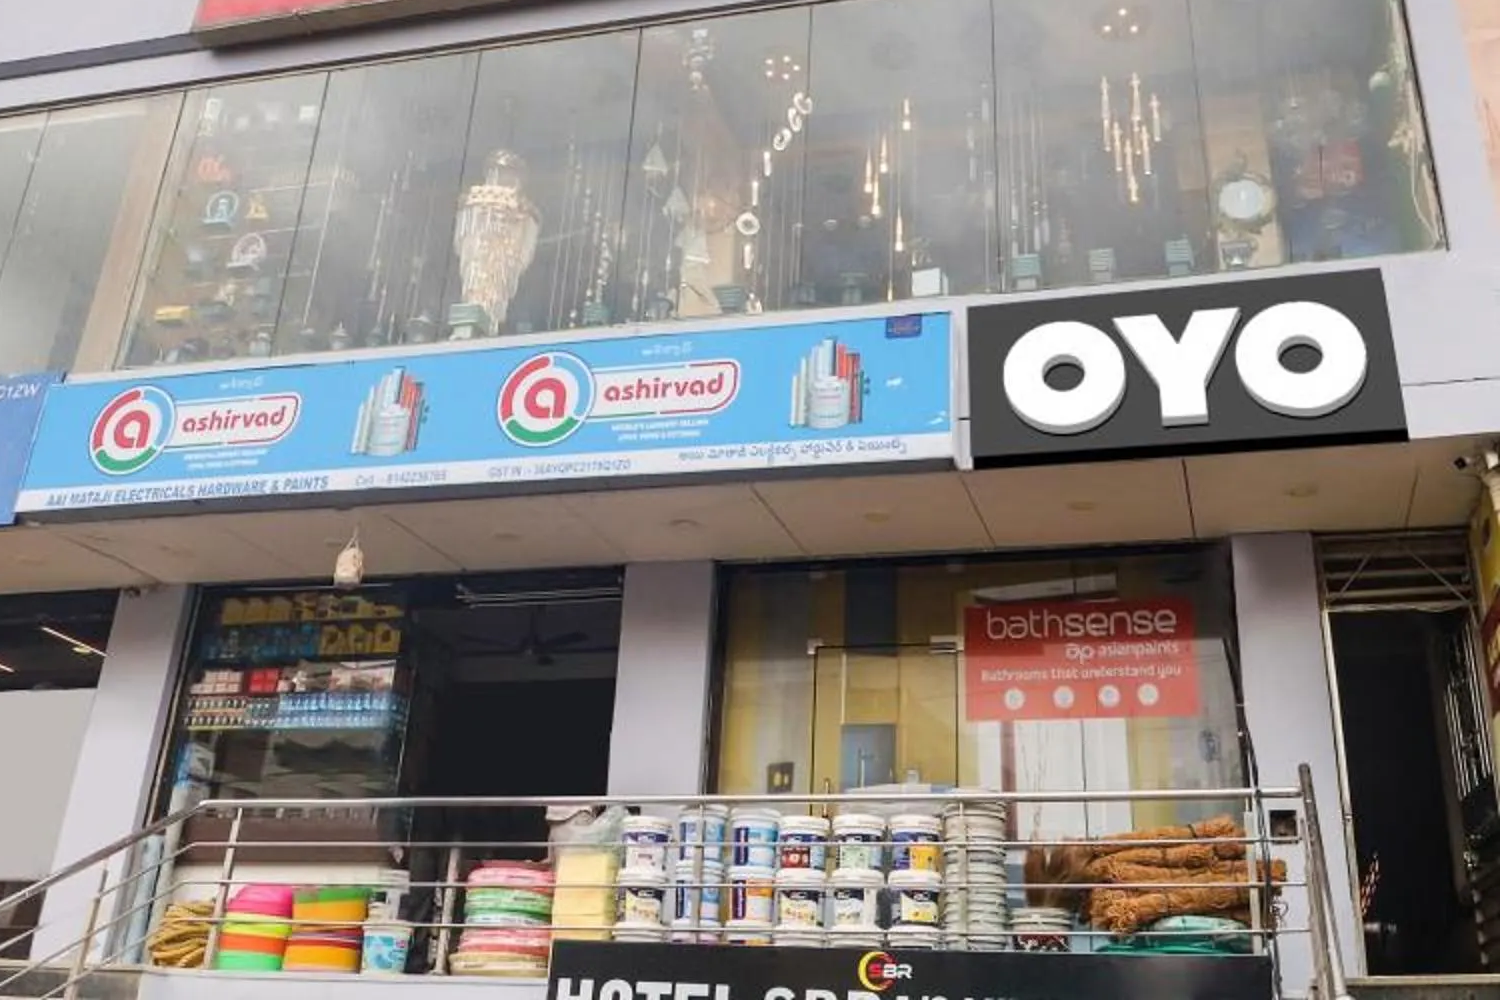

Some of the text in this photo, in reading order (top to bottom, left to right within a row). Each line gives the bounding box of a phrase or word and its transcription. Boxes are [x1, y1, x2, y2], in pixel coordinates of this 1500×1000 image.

[1003, 299, 1368, 436] OYO
[604, 372, 724, 401] ashirvad
[182, 404, 287, 432] ashirvad
[114, 484, 195, 503] ELECTRICALS
[198, 479, 267, 499] HARDWARE
[284, 475, 329, 491] PAINTS
[986, 608, 1177, 640] bathsense
[1099, 640, 1179, 659] asianpaints
[981, 663, 1182, 683] Bathrooms that understand you
